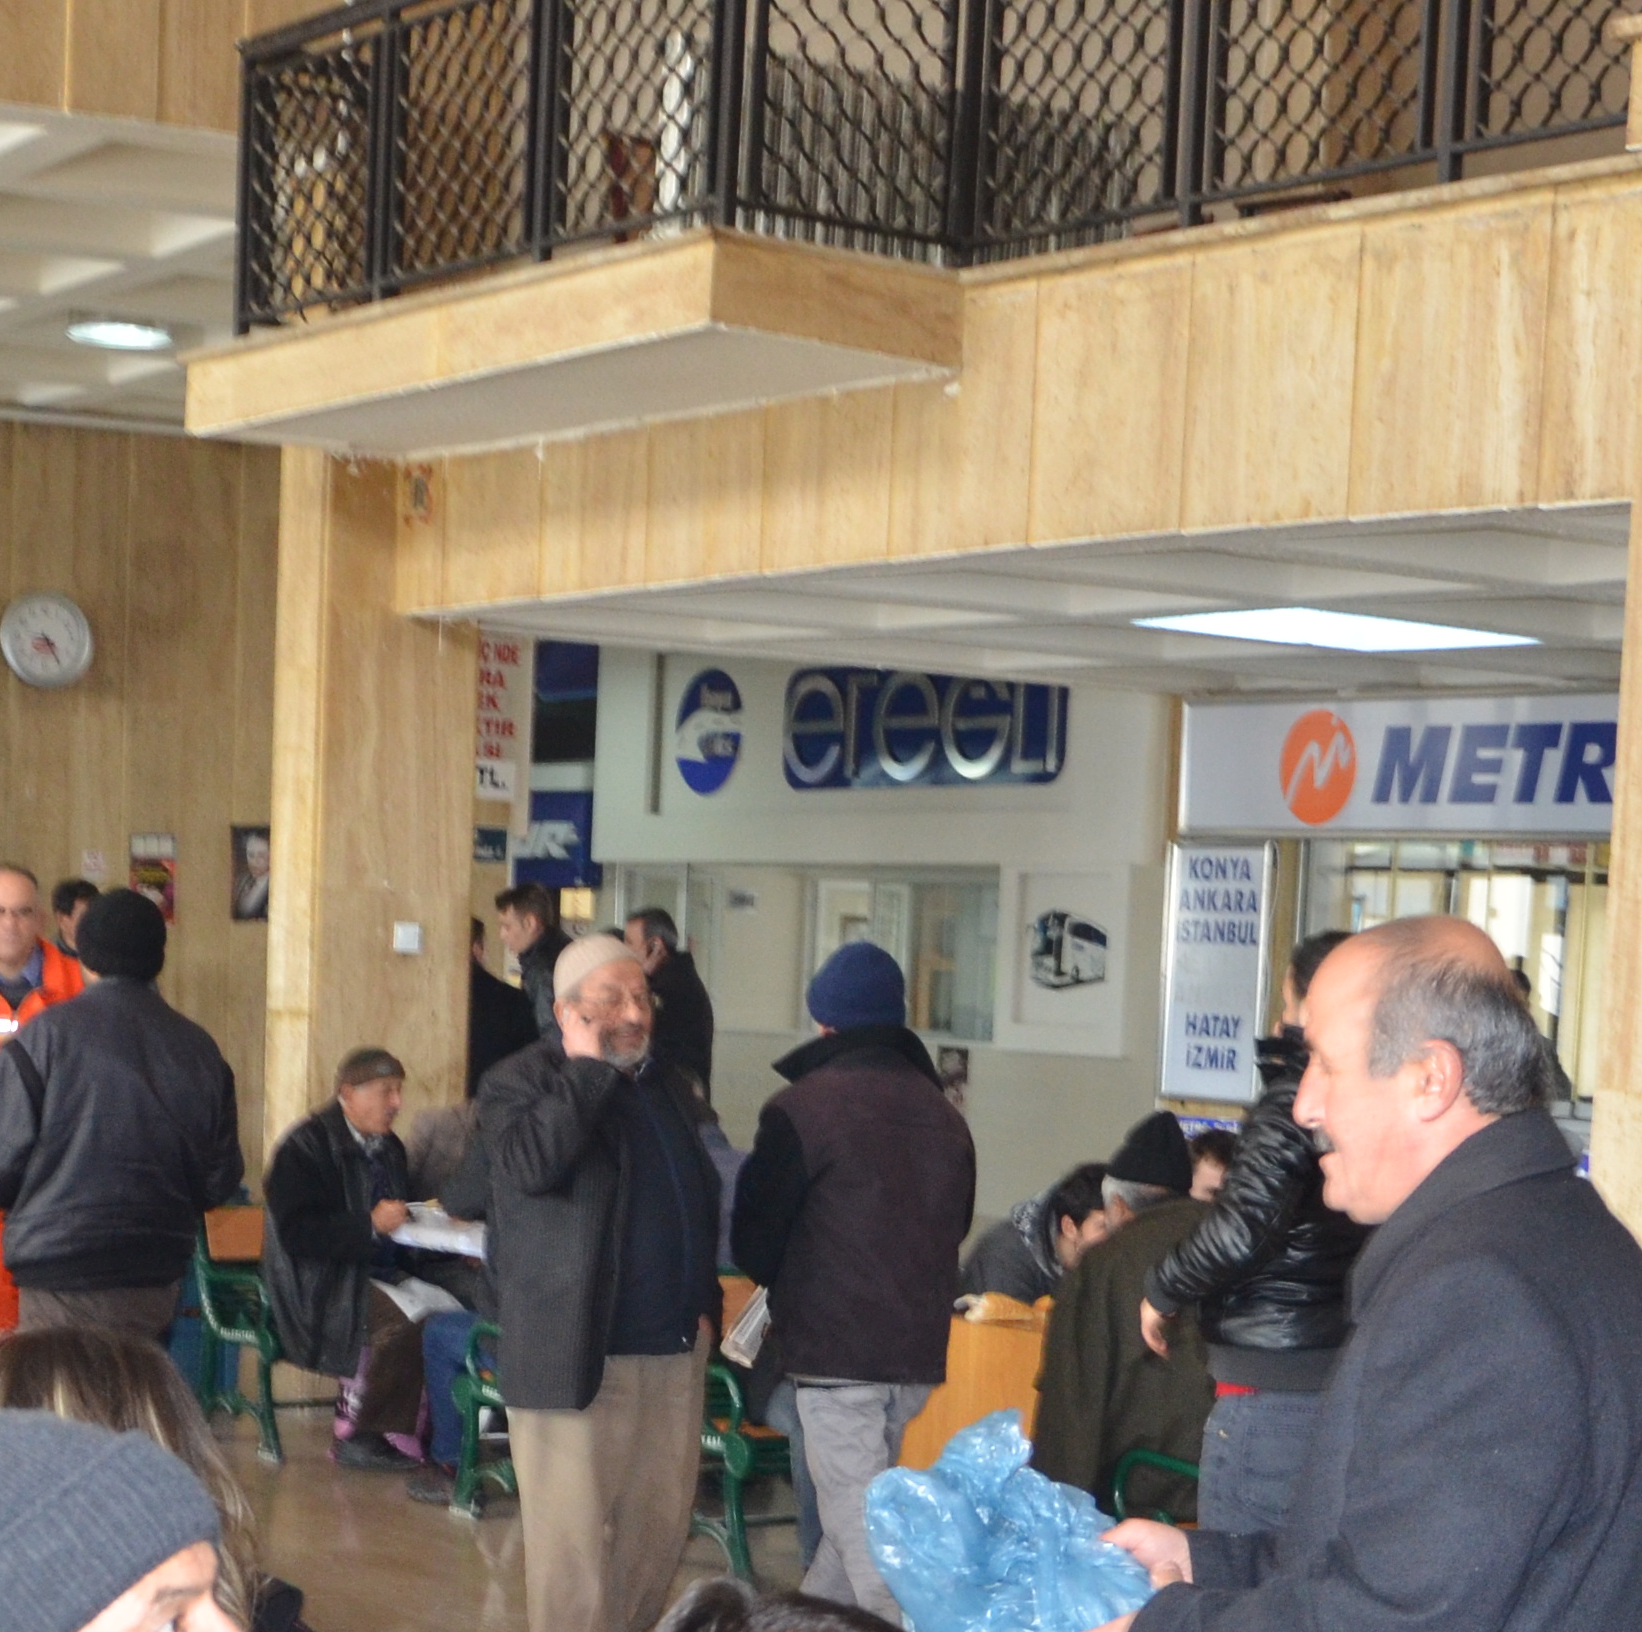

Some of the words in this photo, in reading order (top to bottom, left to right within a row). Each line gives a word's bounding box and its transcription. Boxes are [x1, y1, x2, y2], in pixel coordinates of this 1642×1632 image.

[1188, 855, 1252, 882] KONYA
[1178, 887, 1258, 913] ANKARA
[1184, 1011, 1241, 1039] HATAY
